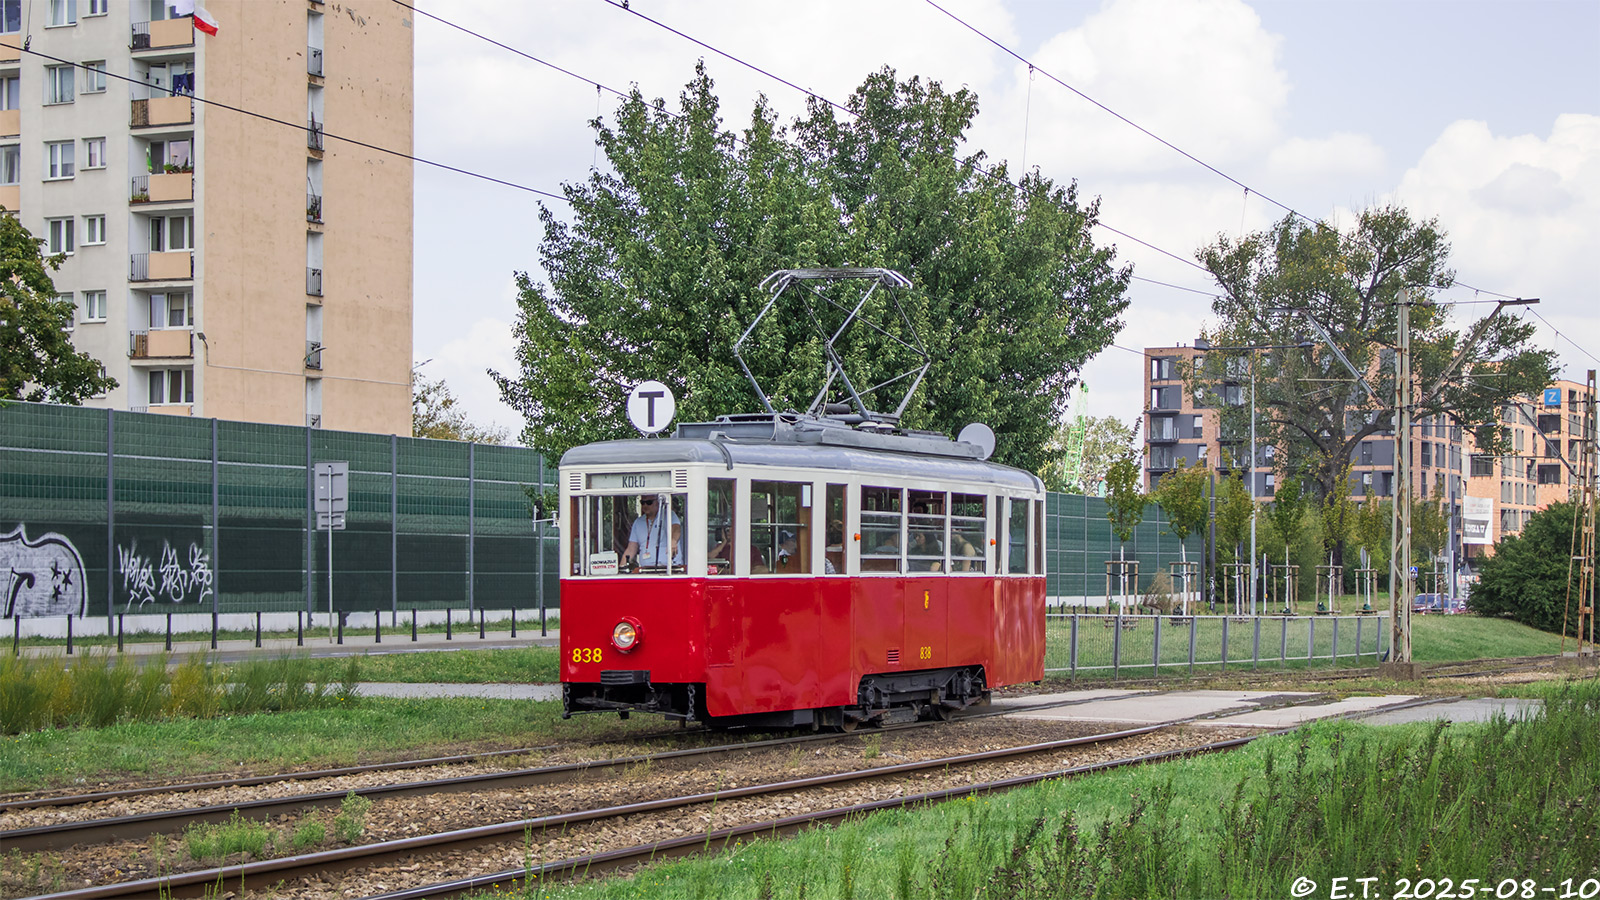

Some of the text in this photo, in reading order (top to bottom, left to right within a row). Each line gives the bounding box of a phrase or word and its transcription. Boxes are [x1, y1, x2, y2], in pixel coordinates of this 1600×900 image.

[1548, 391, 1557, 402] Z
[638, 391, 664, 427] T
[622, 475, 646, 488] KOŁO
[572, 647, 603, 663] 838
[919, 646, 932, 660] 838
